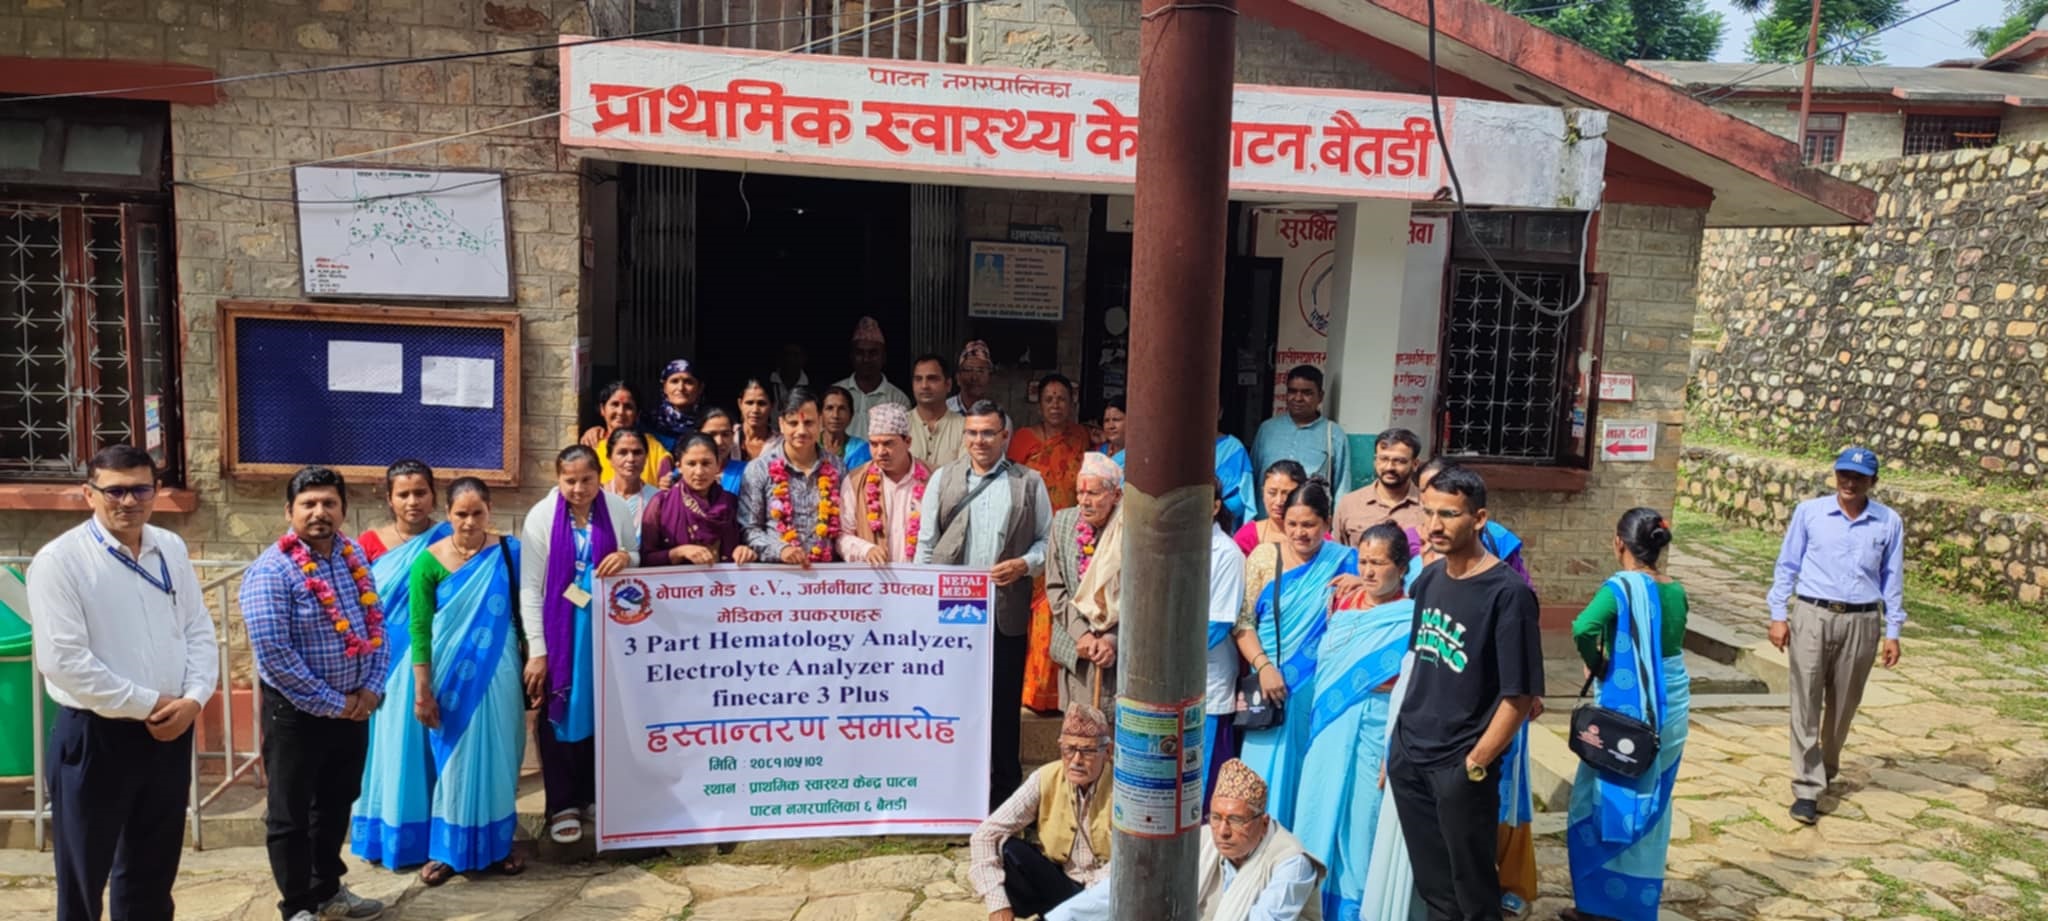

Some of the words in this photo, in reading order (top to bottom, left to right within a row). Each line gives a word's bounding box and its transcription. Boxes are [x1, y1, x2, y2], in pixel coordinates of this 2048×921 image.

[868, 68, 929, 90] पाटन
[943, 72, 1073, 99] नगरपालिका
[589, 79, 853, 146] प्राथमिक
[862, 101, 1077, 160] स्वास्थ्य
[655, 583, 704, 600] नेपाल
[709, 581, 737, 597] मेड
[879, 581, 934, 596] उपलब्ध
[942, 575, 984, 586] NEPAL
[717, 606, 783, 623] मेडिकल
[624, 637, 637, 655] 3
[647, 634, 700, 654] Part
[709, 629, 855, 653] Hematology
[861, 630, 973, 652] Analyzer,
[646, 660, 780, 683] Electrolyte
[785, 657, 895, 680] Analyzer
[901, 658, 945, 677] and
[712, 688, 810, 708] finecare
[816, 685, 831, 704] 3
[839, 684, 890, 704] Plus
[645, 716, 830, 753] हस्तान्तरण
[836, 706, 961, 745] समारोह
[708, 755, 737, 771] मिति
[703, 783, 736, 796] स्थान
[749, 777, 800, 794] प्राथमिक
[852, 775, 883, 790] केन्द्र
[885, 776, 918, 789] पाटन
[749, 804, 782, 817] पाटन
[785, 798, 860, 816] नगरपालिका
[863, 800, 872, 813] ६
